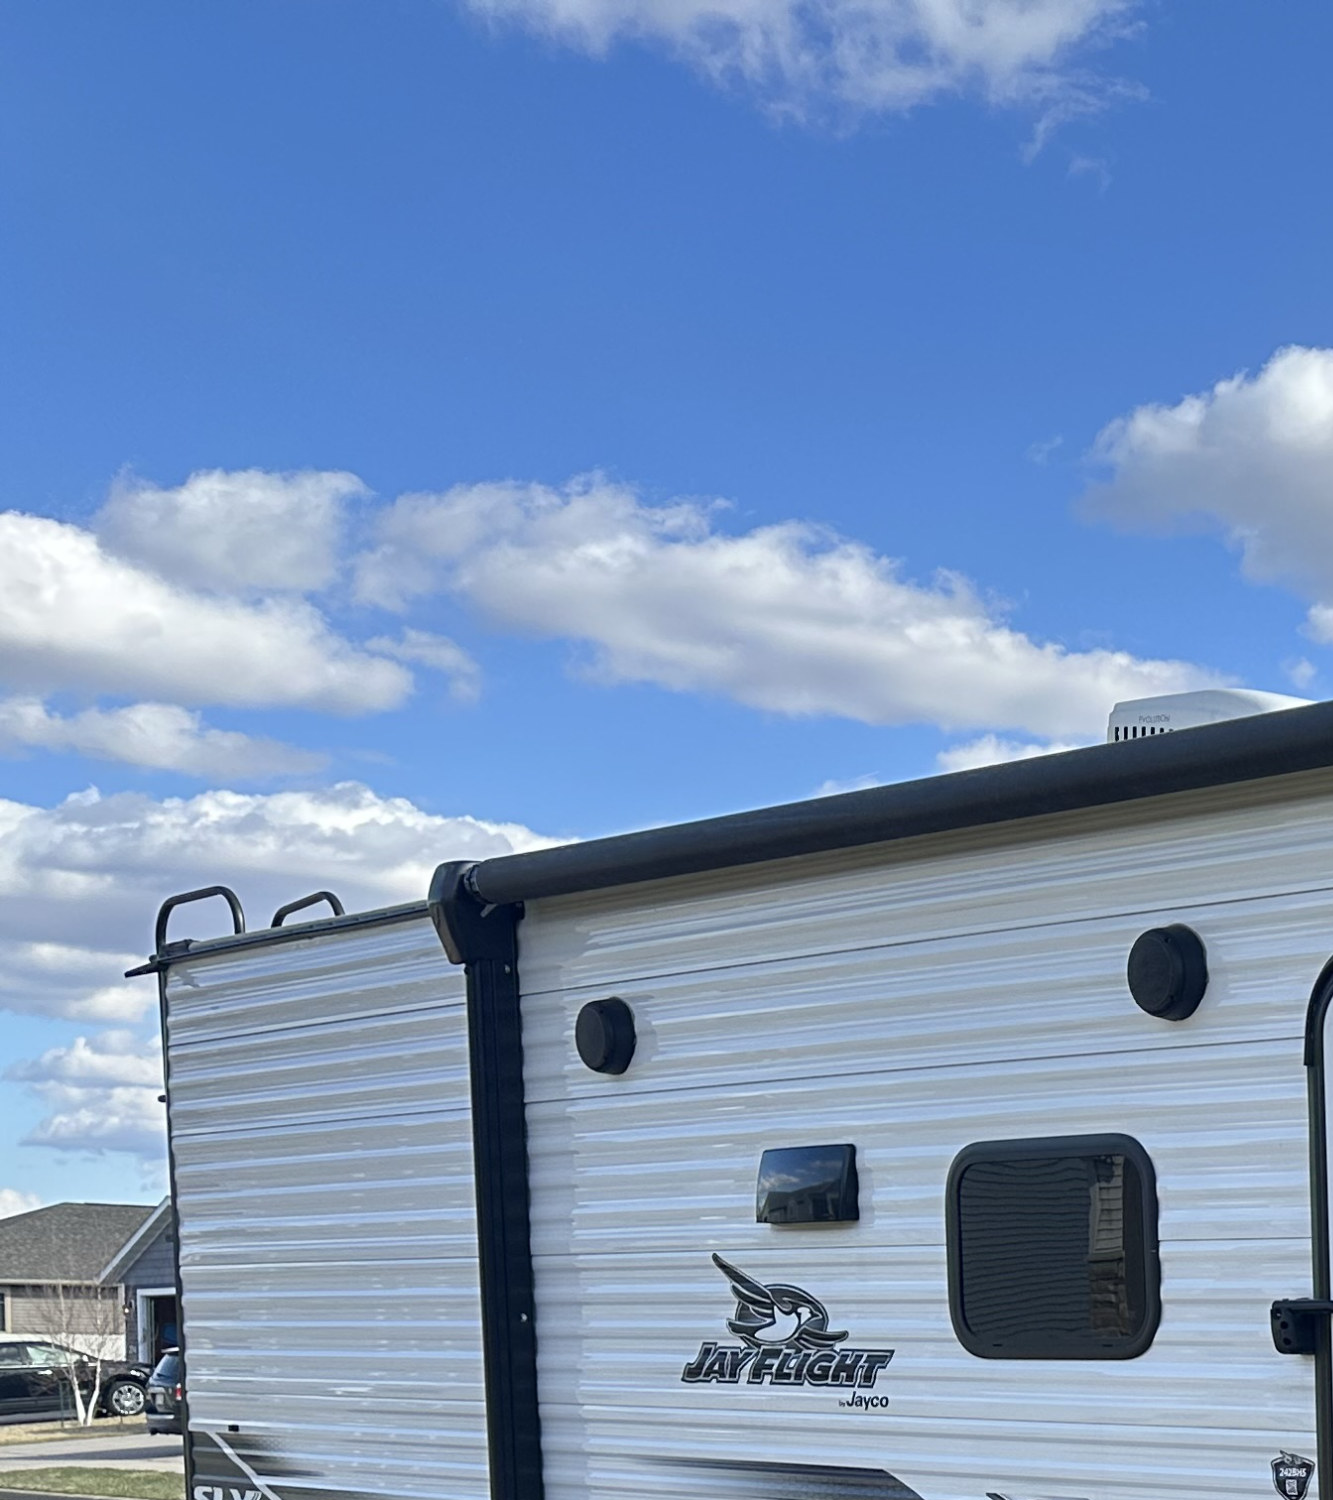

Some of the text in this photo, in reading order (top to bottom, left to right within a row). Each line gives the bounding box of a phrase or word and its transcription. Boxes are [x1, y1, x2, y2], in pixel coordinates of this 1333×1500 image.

[681, 1342, 896, 1389] JAY FLIGHT
[846, 1391, 890, 1411] Jayco
